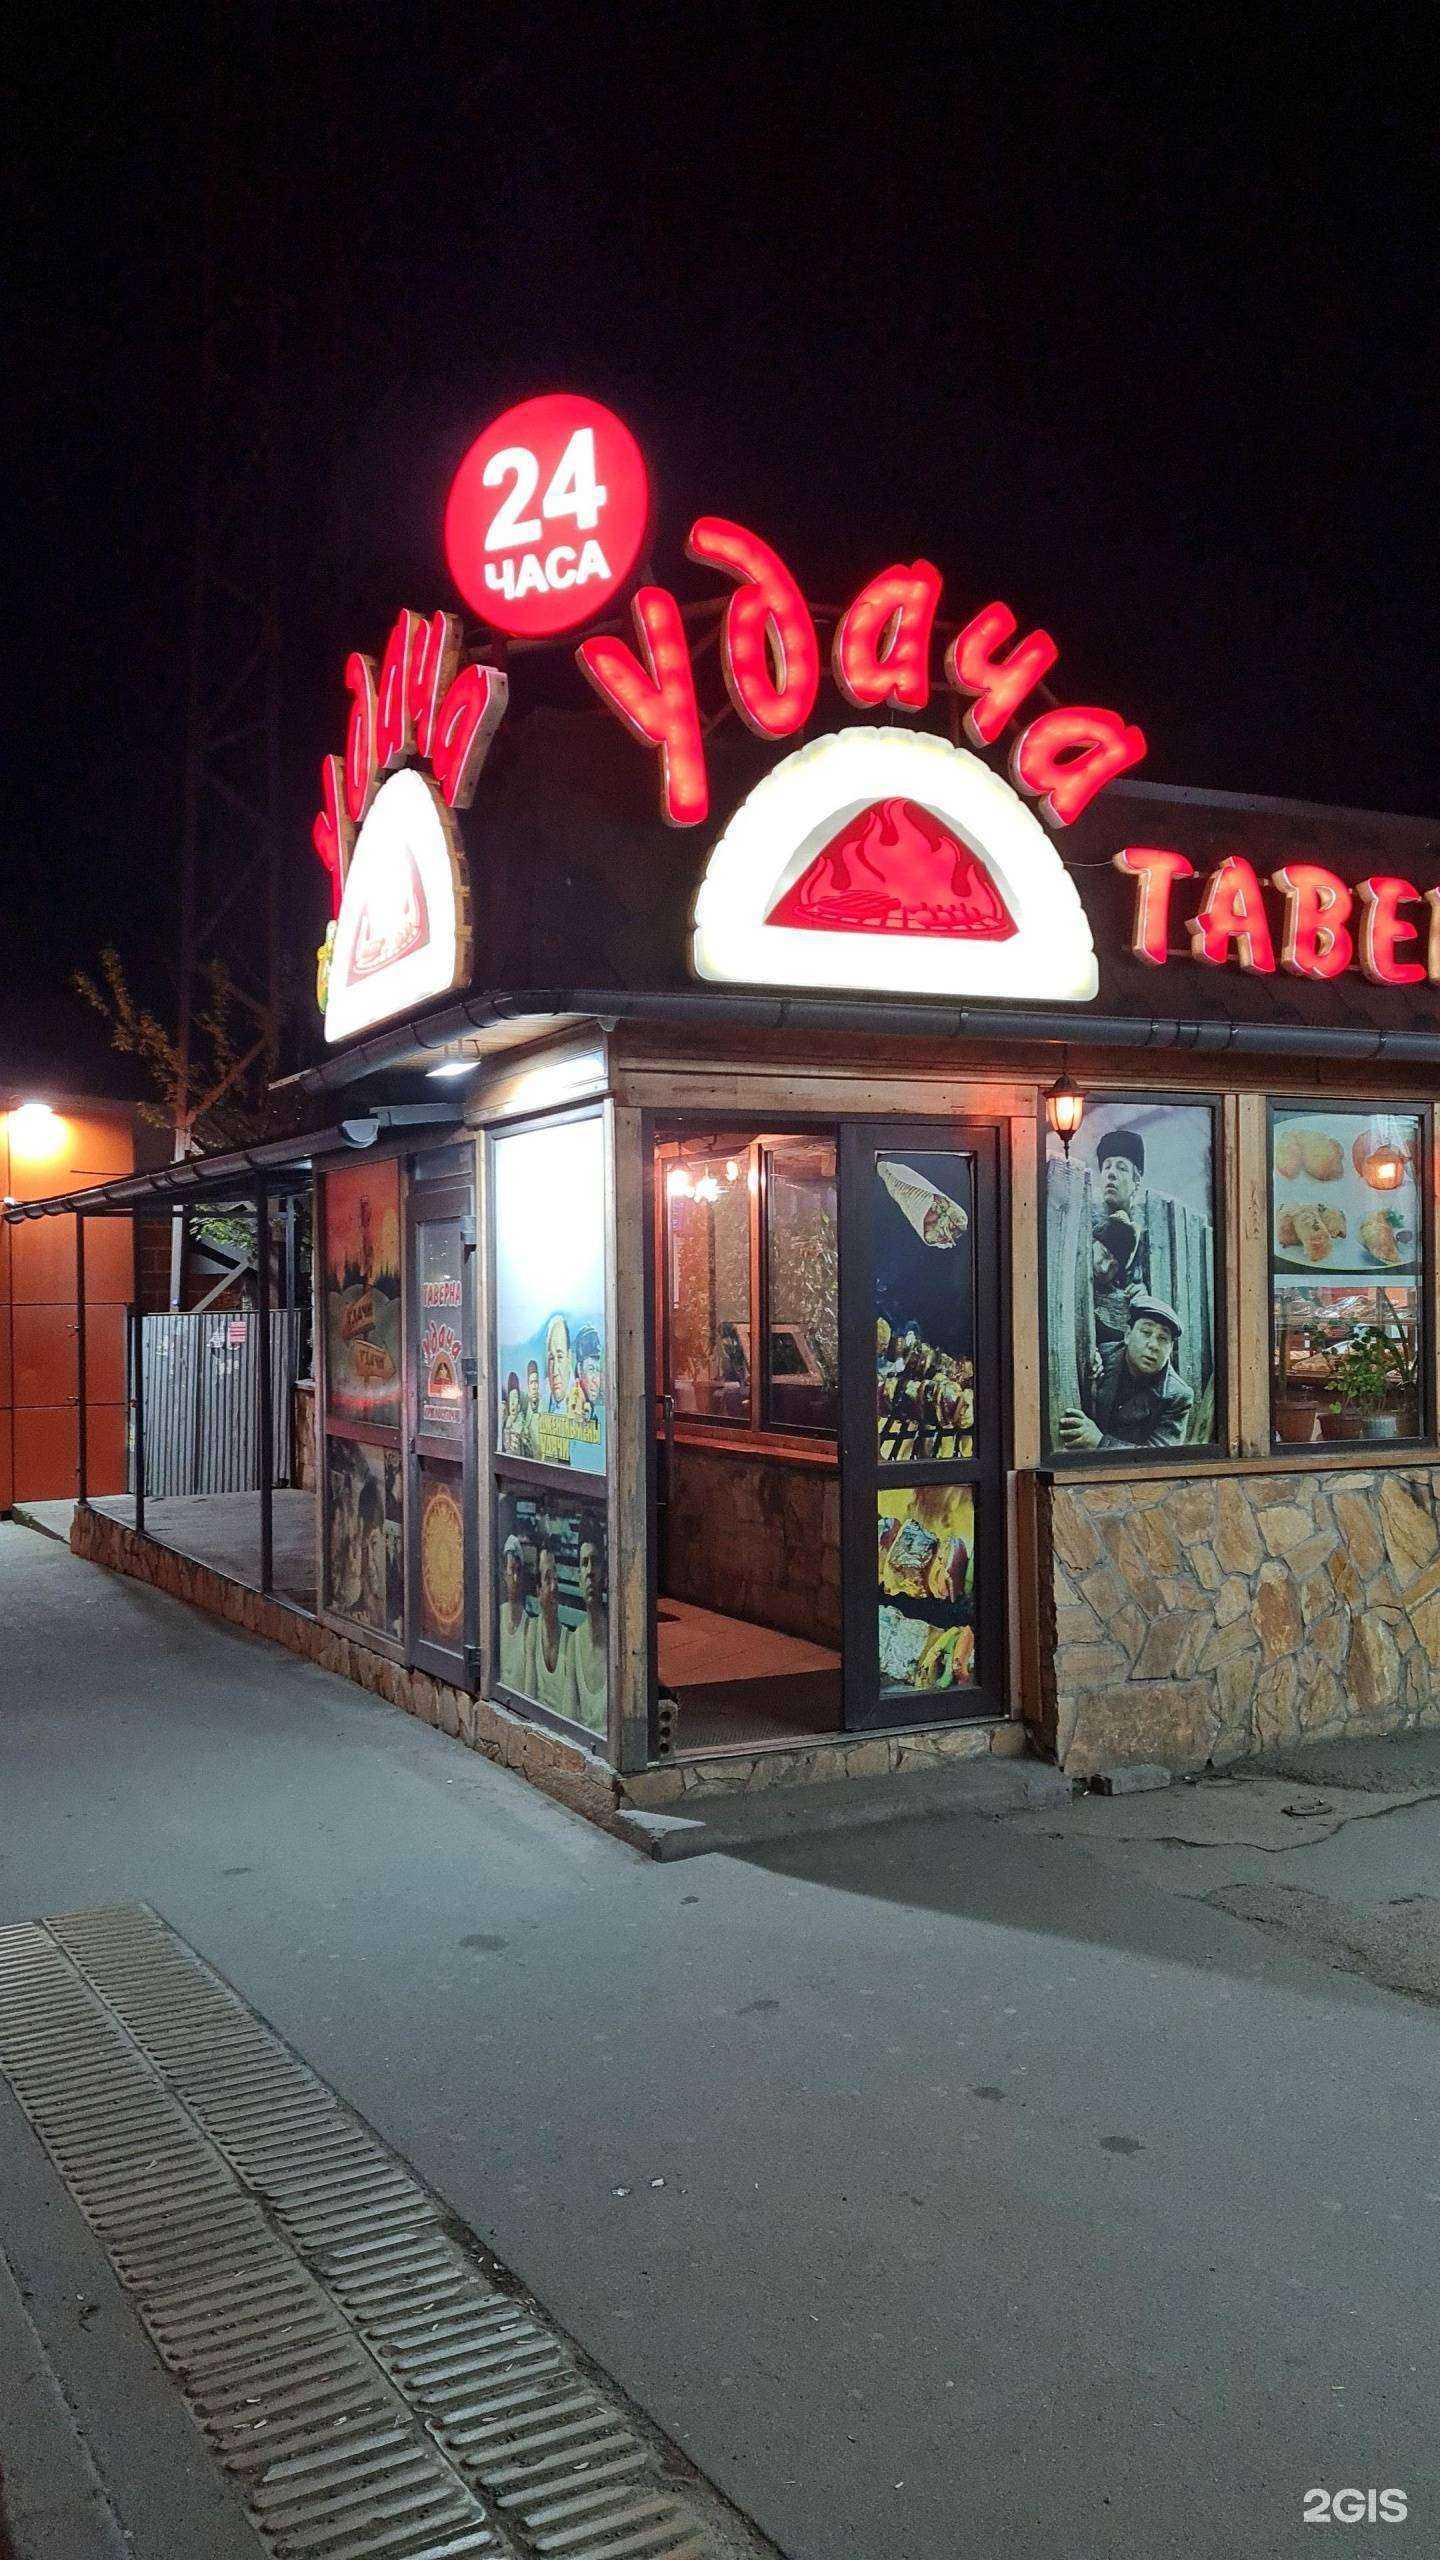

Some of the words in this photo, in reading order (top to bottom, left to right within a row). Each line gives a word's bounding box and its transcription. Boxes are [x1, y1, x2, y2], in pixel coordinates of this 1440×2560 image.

[482, 427, 607, 552] 24
[483, 539, 612, 601] ЧАСА
[1112, 846, 1440, 986] ТАВЕ
